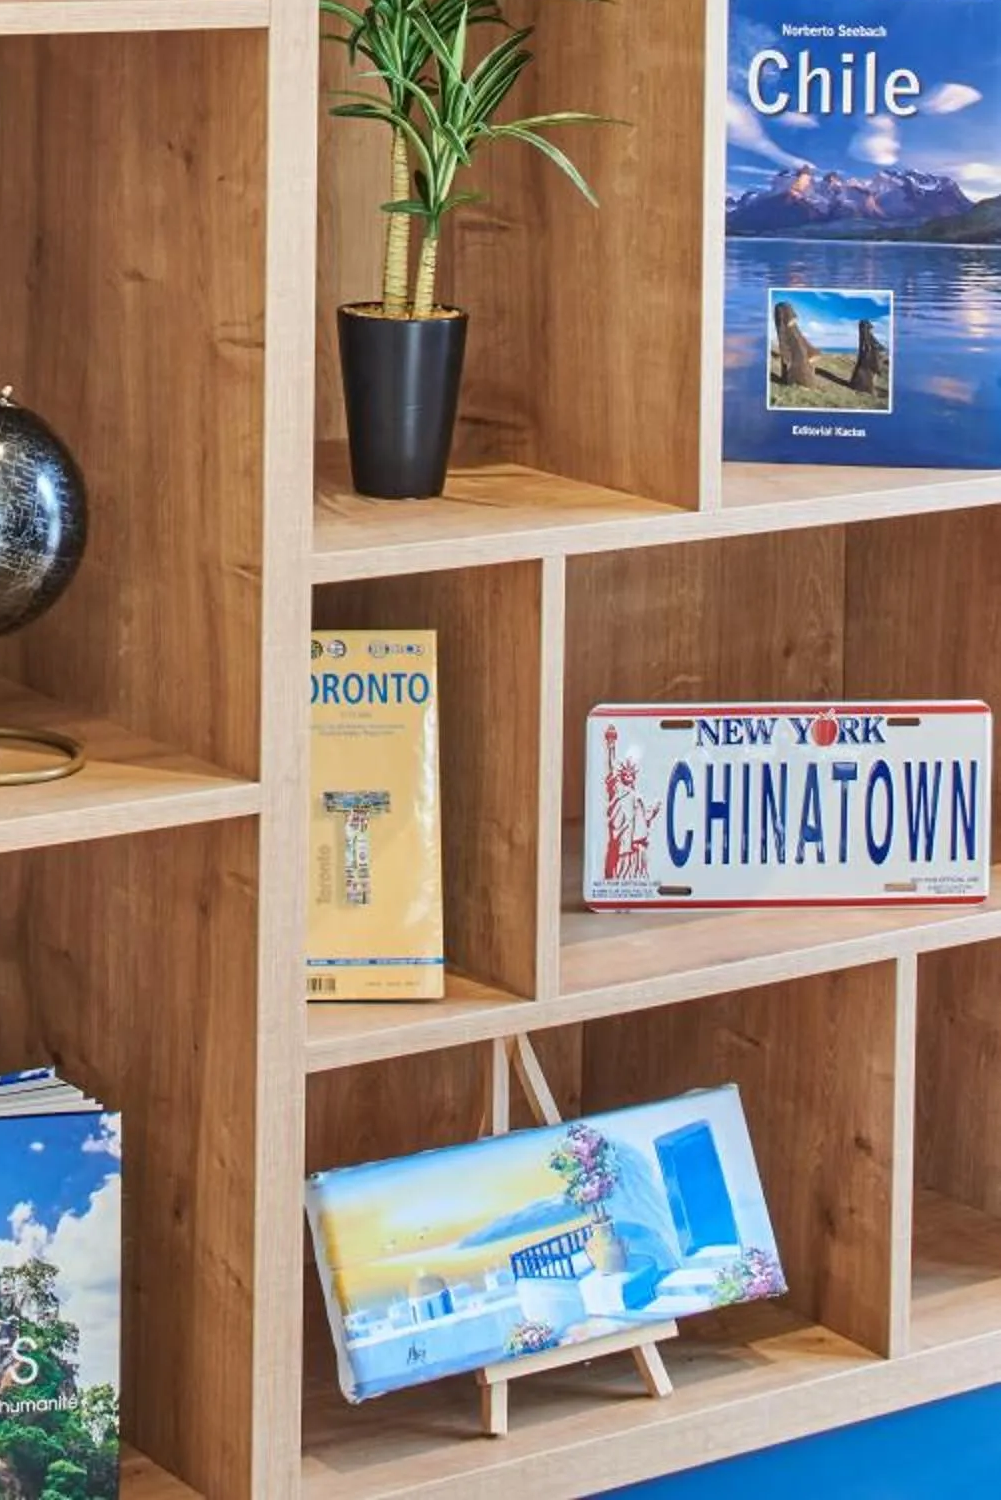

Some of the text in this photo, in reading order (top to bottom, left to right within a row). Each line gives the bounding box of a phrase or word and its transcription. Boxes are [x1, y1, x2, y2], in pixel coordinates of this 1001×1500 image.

[782, 23, 887, 37] Norberto Seebach
[748, 49, 920, 116] Chile
[696, 717, 780, 747] NEW
[666, 758, 978, 868] CHINATOWN
